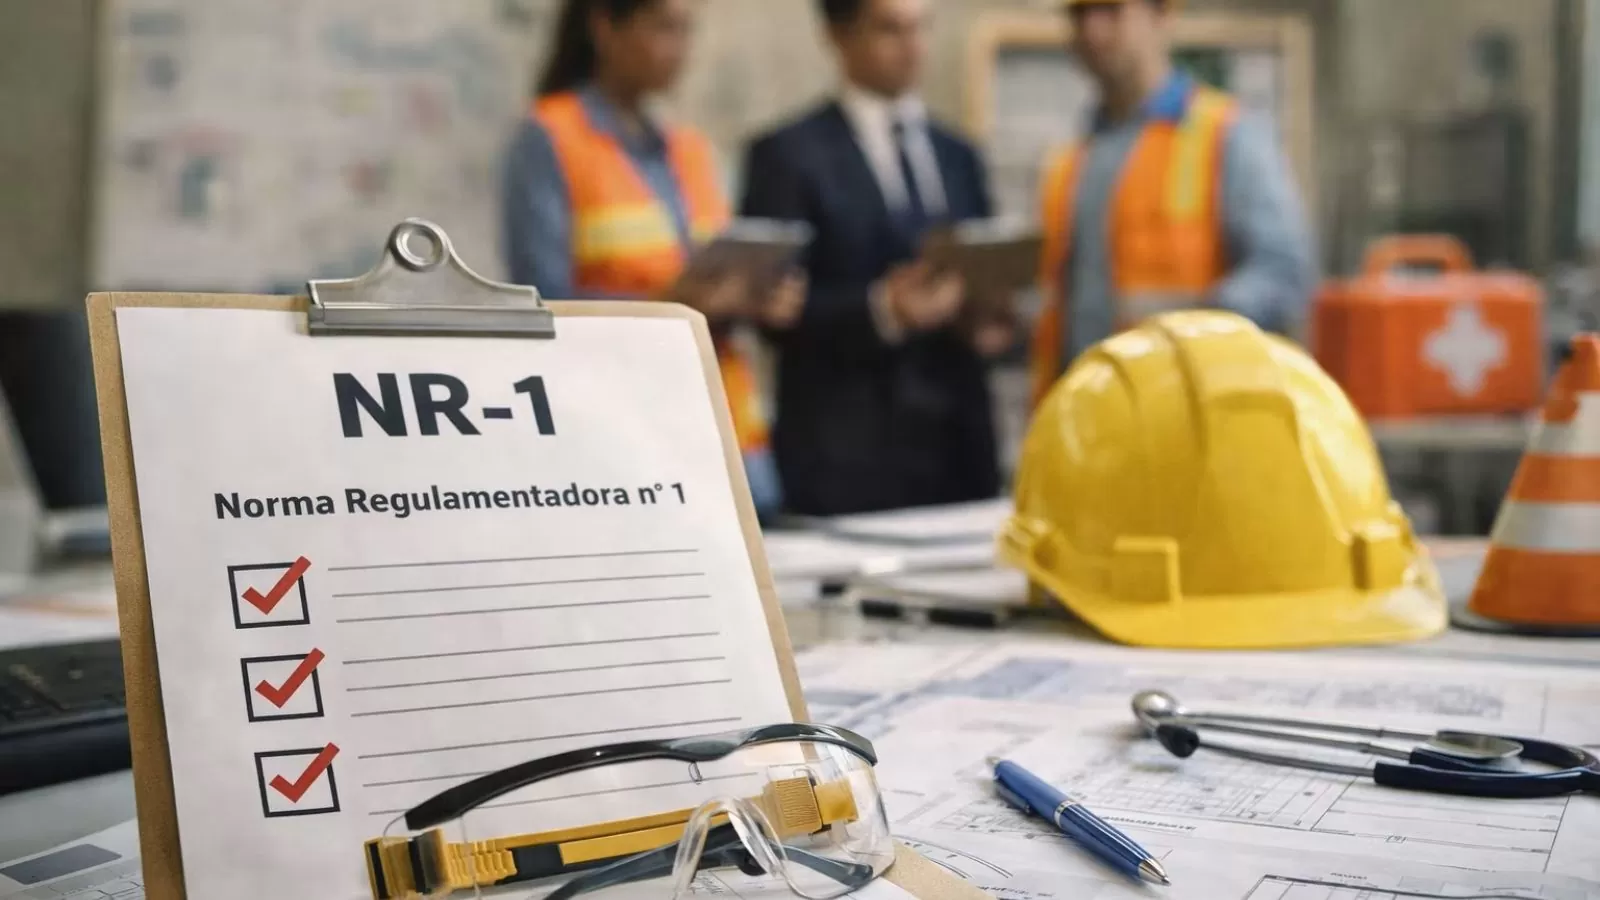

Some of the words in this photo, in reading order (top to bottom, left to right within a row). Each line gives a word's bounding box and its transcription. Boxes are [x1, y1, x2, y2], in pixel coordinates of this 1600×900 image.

[333, 372, 556, 438] NR-1
[214, 492, 335, 520] Norma
[344, 482, 631, 519] Regulamentadora
[671, 482, 686, 504] 1
